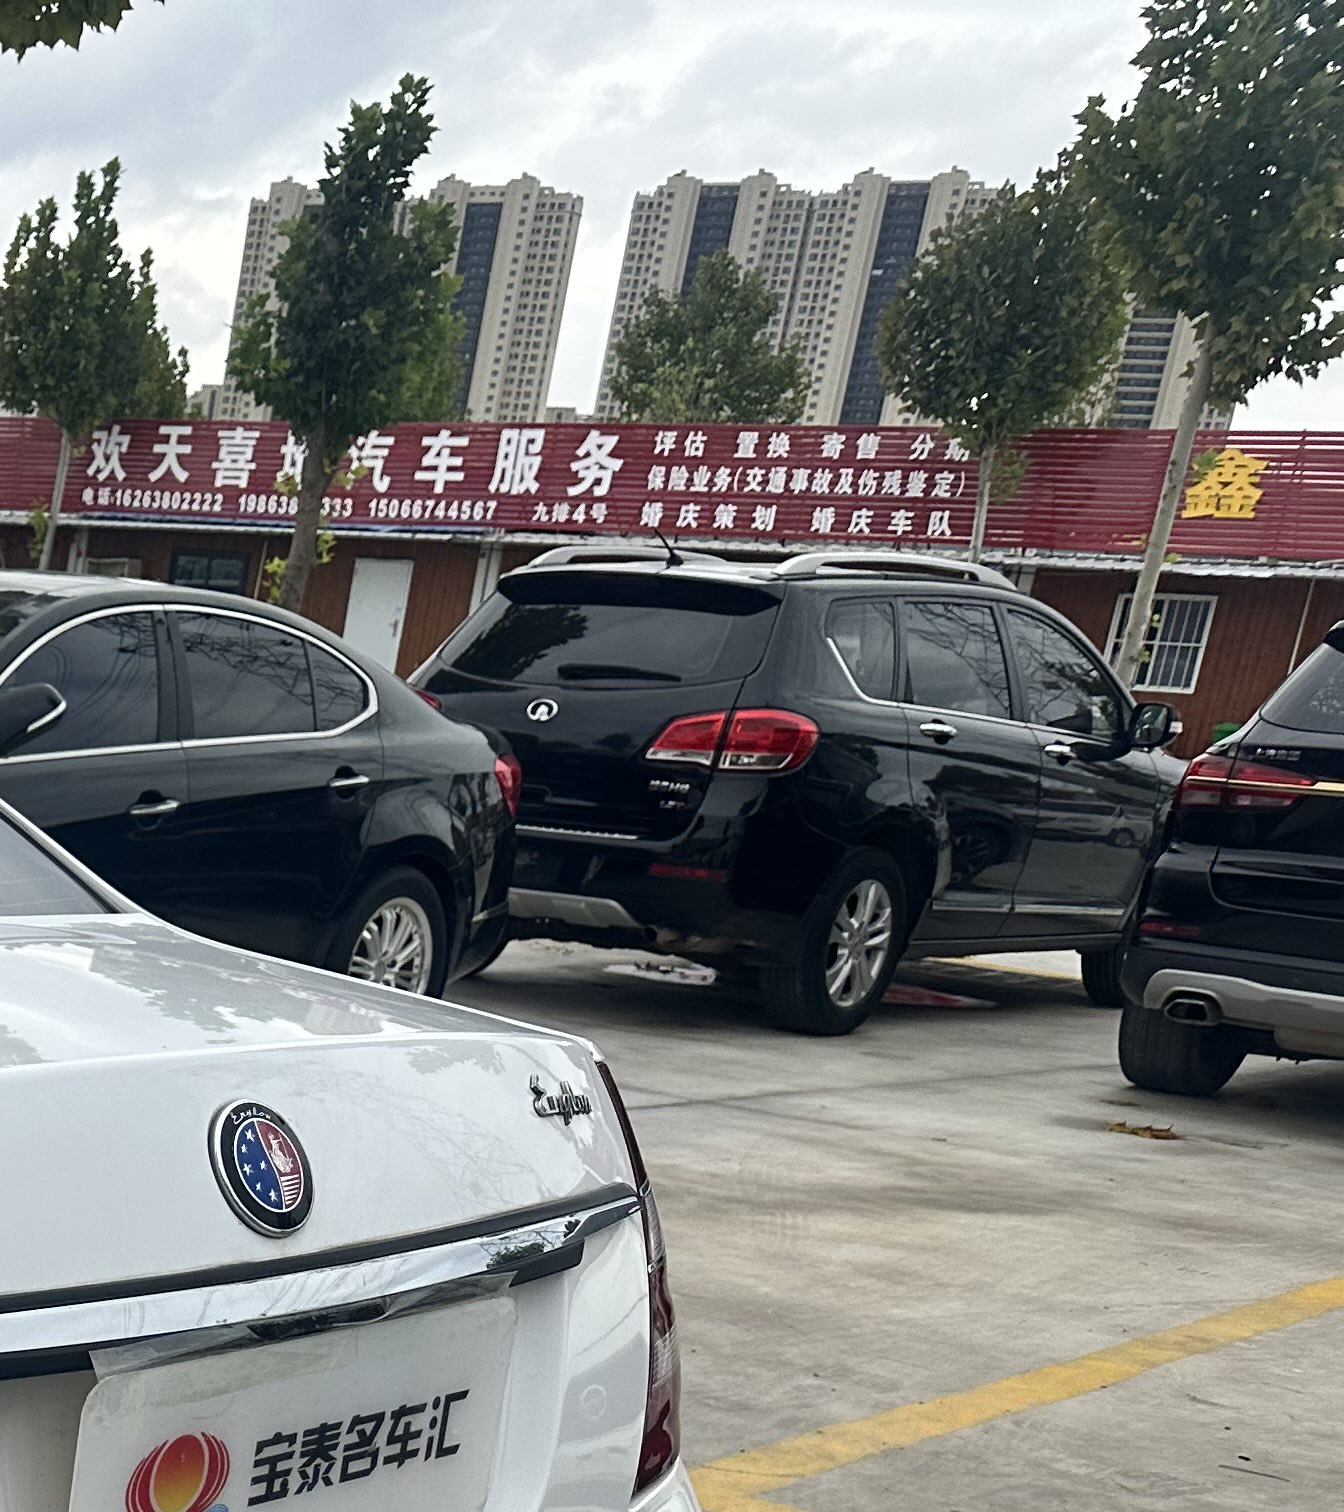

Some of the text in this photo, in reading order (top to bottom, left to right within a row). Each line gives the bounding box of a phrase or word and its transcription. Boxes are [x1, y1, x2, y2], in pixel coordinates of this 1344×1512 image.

[653, 430, 707, 457] 评估
[734, 431, 790, 459] 置换
[821, 432, 880, 460] 寄售
[1181, 448, 1270, 519] 鑫
[238, 493, 353, 518] 198638333
[368, 497, 498, 522] 15066744567
[532, 501, 609, 525] 九排4号
[639, 502, 952, 537] 婚庆策划 婚庆车队
[247, 1389, 470, 1507] 宝泰名车汇
